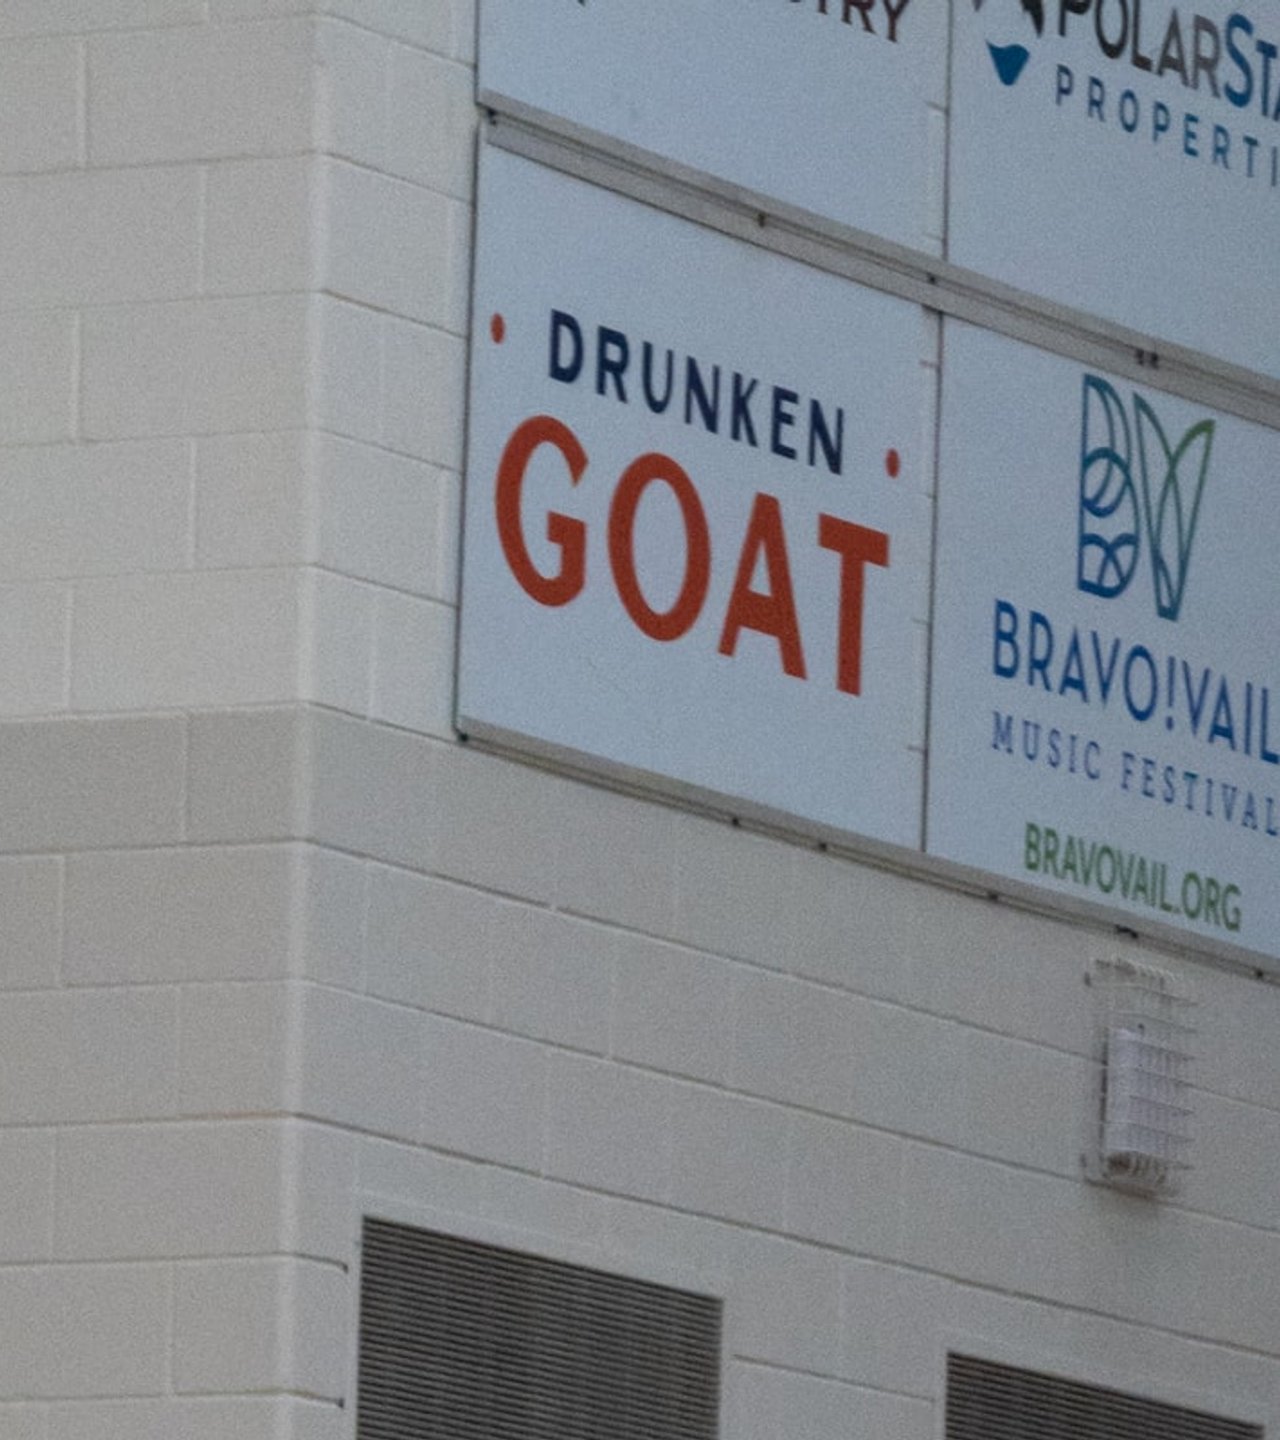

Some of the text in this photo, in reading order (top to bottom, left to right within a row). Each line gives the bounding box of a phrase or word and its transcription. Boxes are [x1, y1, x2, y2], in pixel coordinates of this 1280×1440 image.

[548, 308, 845, 476] DRUNKEN
[493, 414, 890, 698] GOAT
[991, 710, 1279, 838] MUSIC FESTIVAL
[1023, 821, 1242, 933] BRAVOVAIL.ORG
